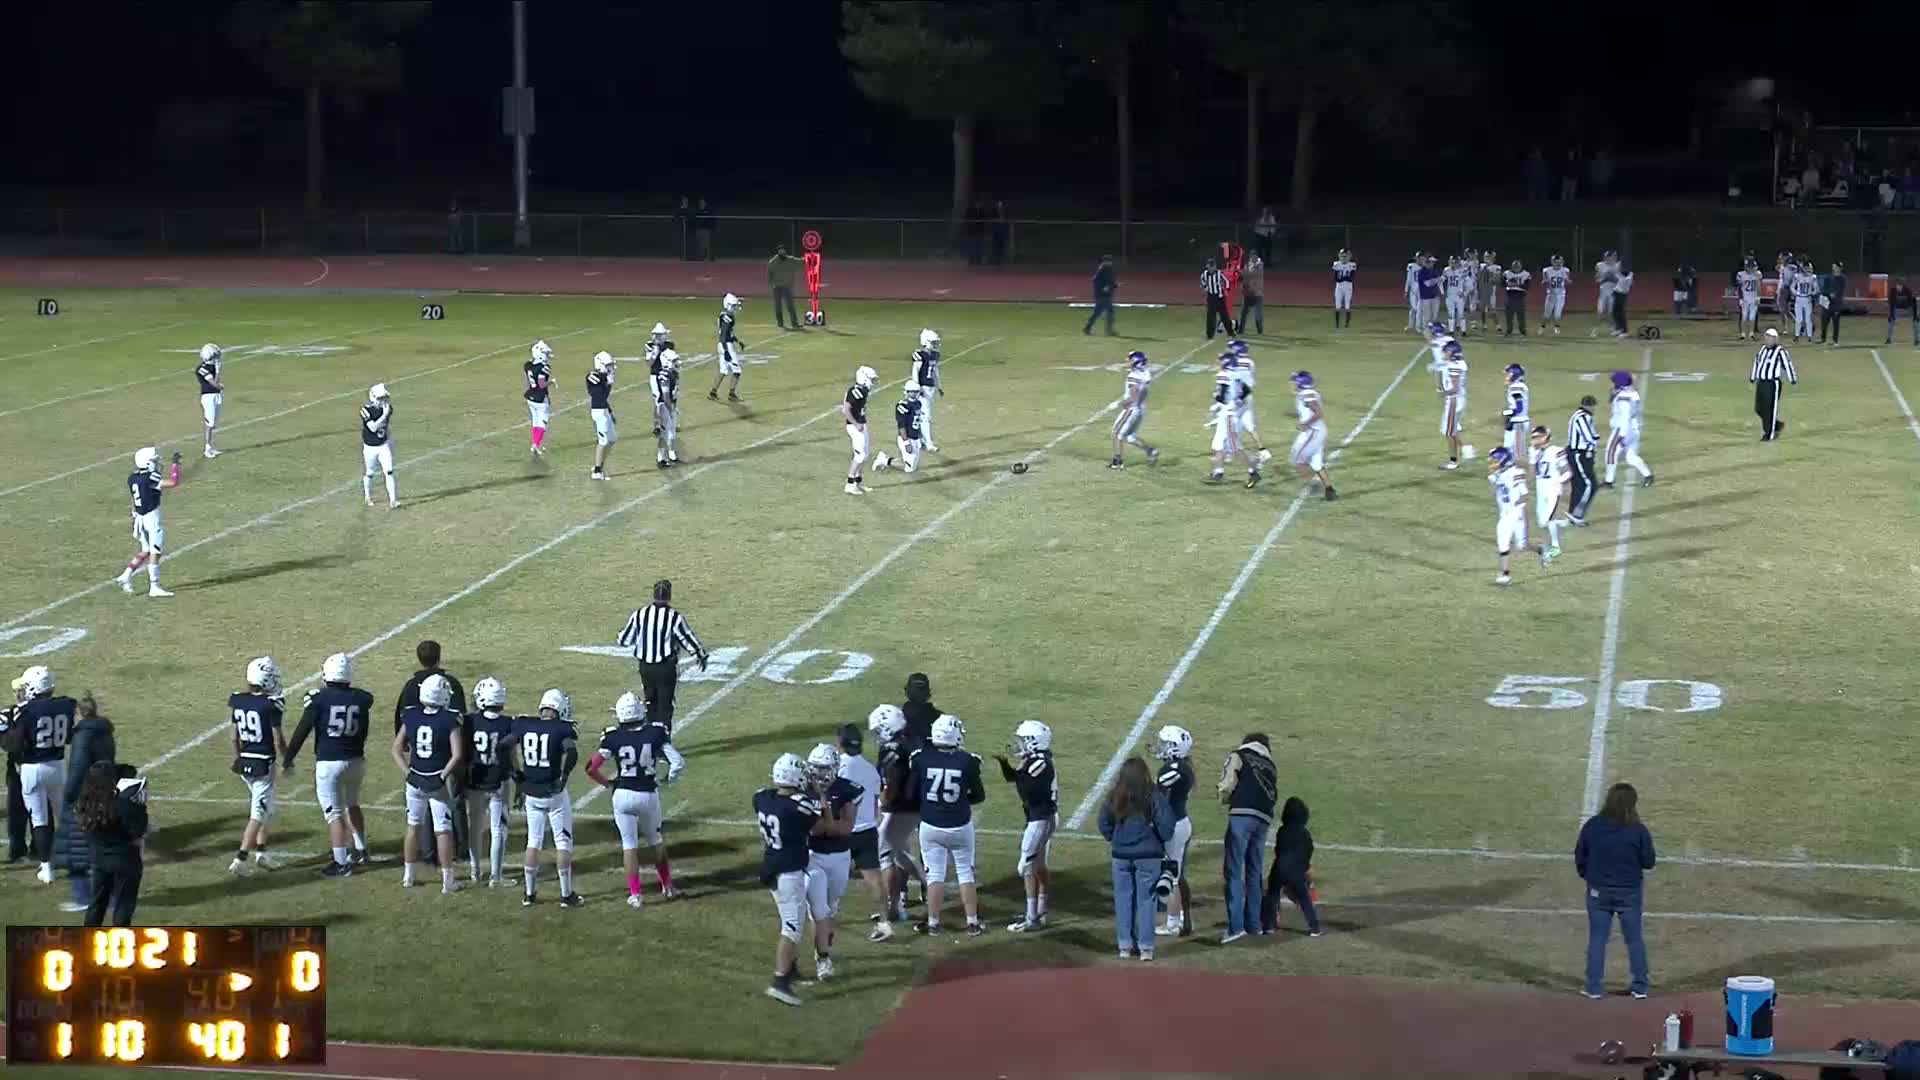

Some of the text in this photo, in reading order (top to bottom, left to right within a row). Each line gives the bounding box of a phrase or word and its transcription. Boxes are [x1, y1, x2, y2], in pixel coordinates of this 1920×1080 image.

[41, 300, 57, 314] 10
[423, 305, 441, 320] 20
[805, 311, 823, 325] 30
[1487, 674, 1723, 713] 50
[35, 714, 68, 748] 28
[234, 709, 262, 743] 29
[327, 704, 360, 737] 56
[416, 725, 433, 758] 8
[523, 732, 550, 768] 81
[618, 743, 656, 777] 24
[926, 768, 962, 803] 75
